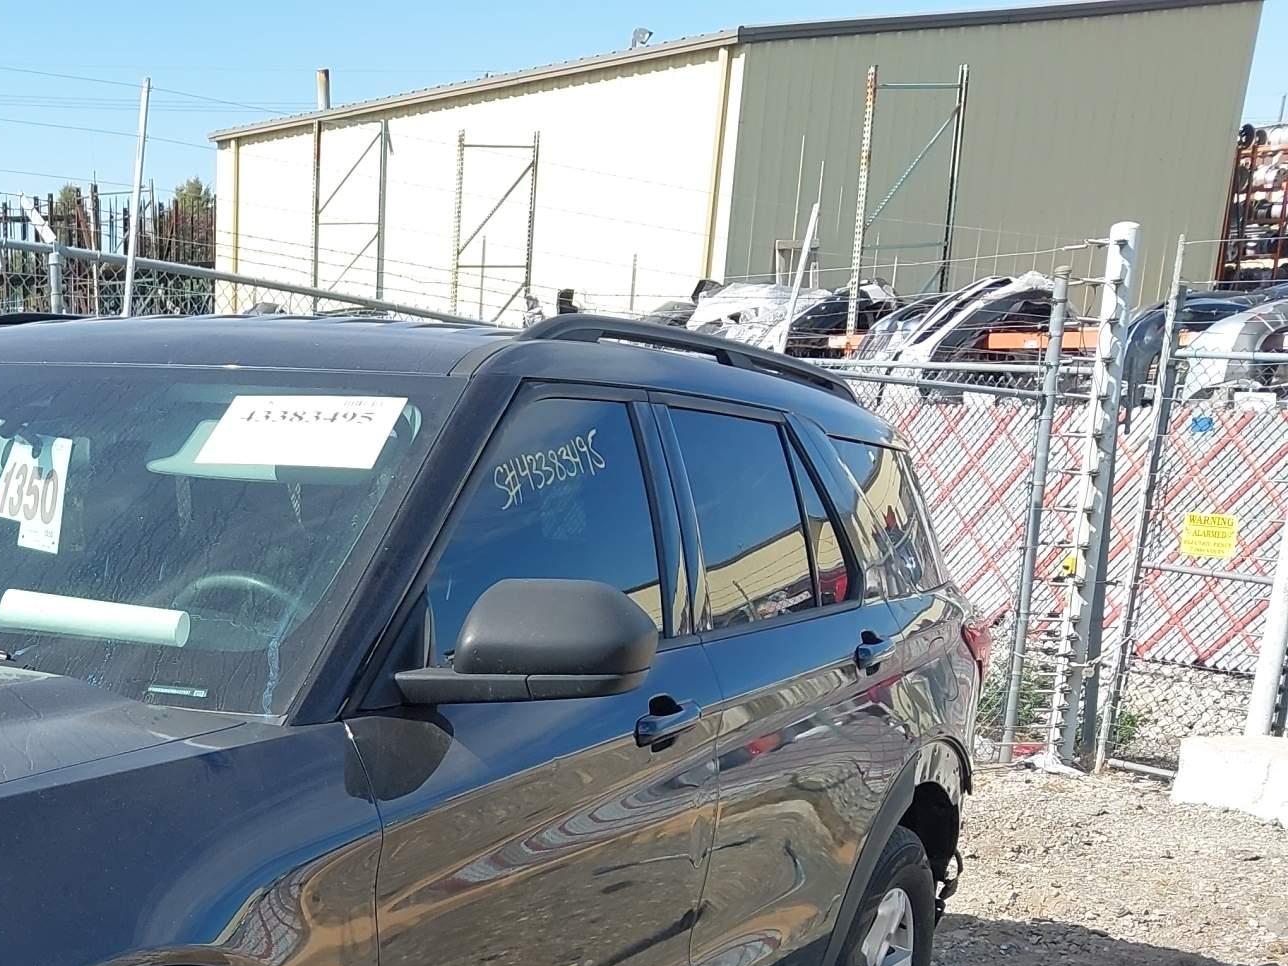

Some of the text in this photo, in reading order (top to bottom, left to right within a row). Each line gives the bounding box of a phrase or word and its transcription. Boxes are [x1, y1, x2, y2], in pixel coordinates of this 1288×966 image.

[240, 409, 376, 424] 43383495
[0, 461, 59, 525] 1350
[1189, 514, 1235, 527] WARNING
[1192, 529, 1227, 539] ALARMED
